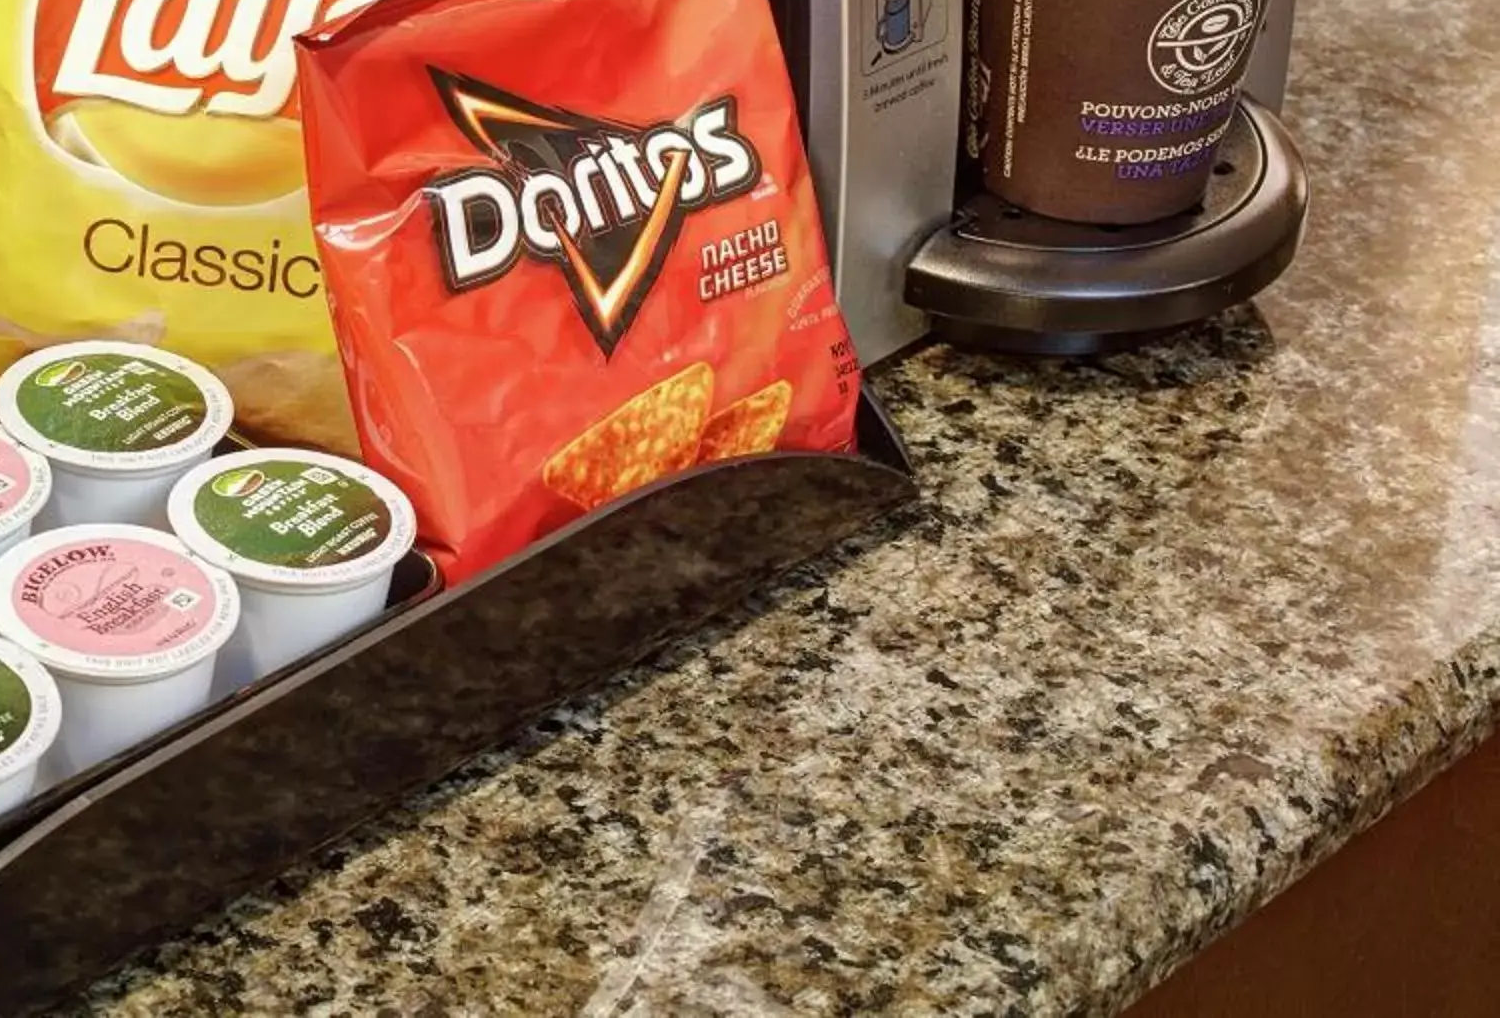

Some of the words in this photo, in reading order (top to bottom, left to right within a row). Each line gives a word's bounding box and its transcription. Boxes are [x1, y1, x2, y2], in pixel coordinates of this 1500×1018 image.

[1158, 14, 1187, 41] The
[1174, 68, 1198, 89] Tea
[1079, 90, 1230, 120] POUVONS-NOUS
[1079, 116, 1165, 138] VERSER
[1074, 143, 1111, 164] ¿LE
[1114, 137, 1205, 164] PODEMOS
[1117, 161, 1163, 180] UNA
[437, 103, 753, 285] Doritos
[82, 216, 323, 301] Classic
[701, 218, 780, 272] NACHO
[699, 245, 788, 301] CHEESE
[88, 383, 157, 421] Breakfast
[114, 393, 163, 422] Blend
[269, 493, 341, 536] Breakfast
[296, 505, 346, 538] Blend
[20, 544, 112, 607] BIGELOW
[75, 580, 145, 625] English
[87, 586, 167, 637] Breakfast
